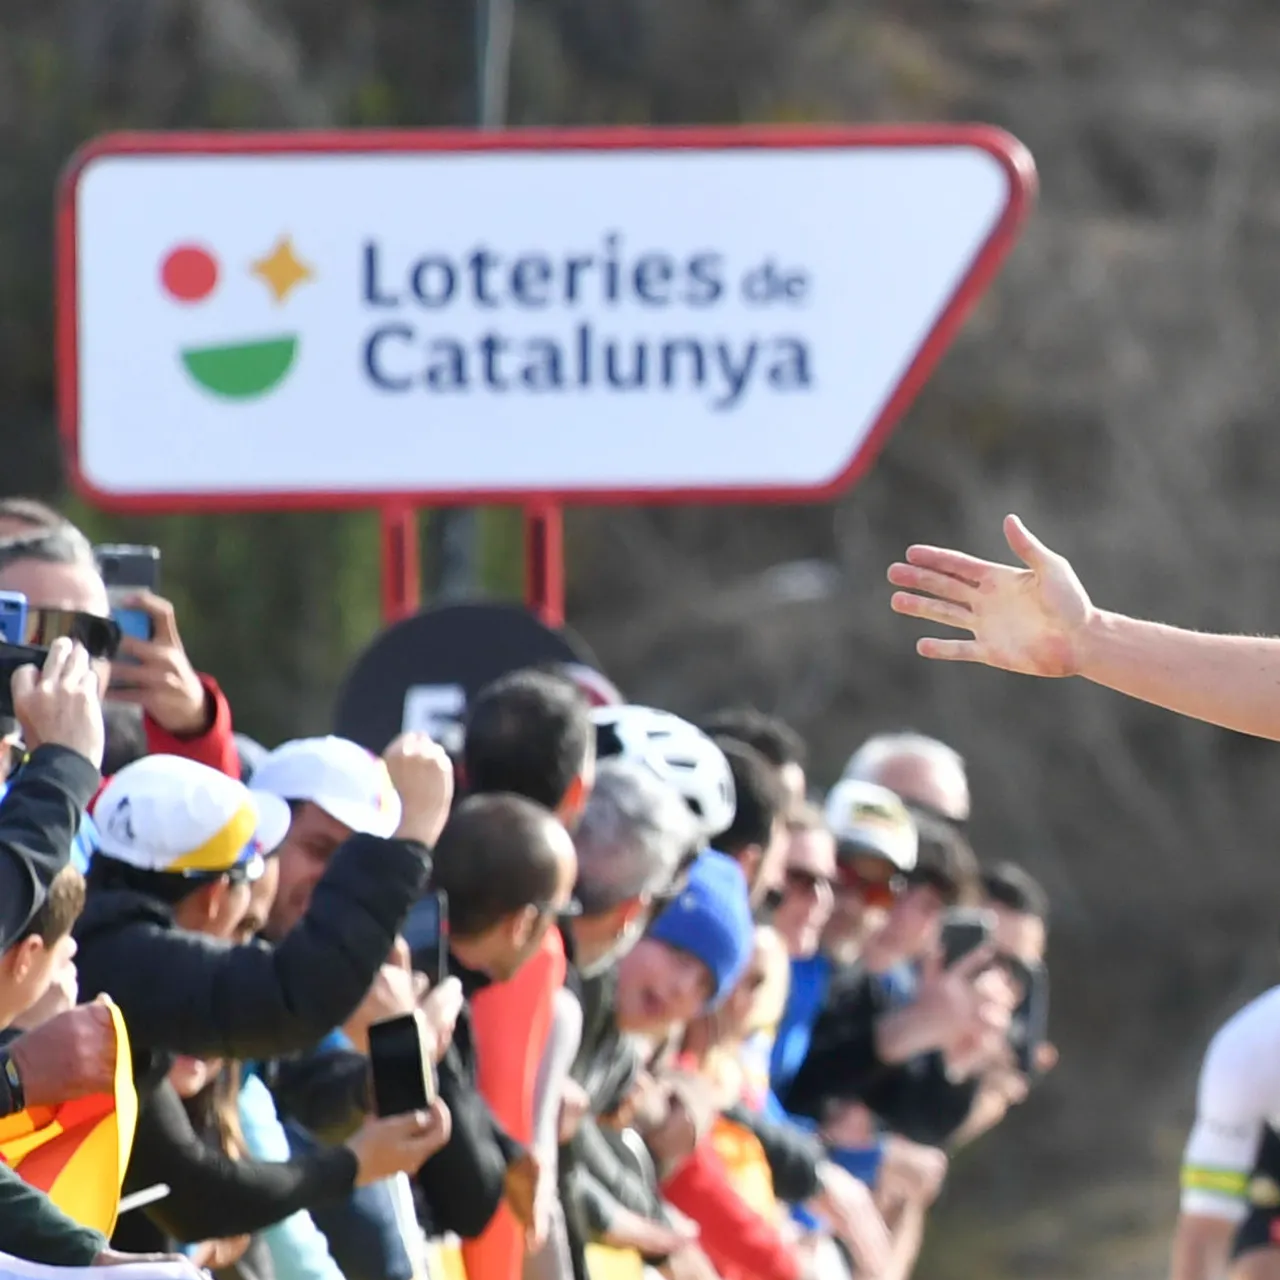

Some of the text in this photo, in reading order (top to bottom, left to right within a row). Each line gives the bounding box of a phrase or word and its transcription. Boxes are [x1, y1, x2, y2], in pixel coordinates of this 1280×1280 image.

[363, 232, 810, 306] Loteries de
[363, 320, 812, 412] Catalunya
